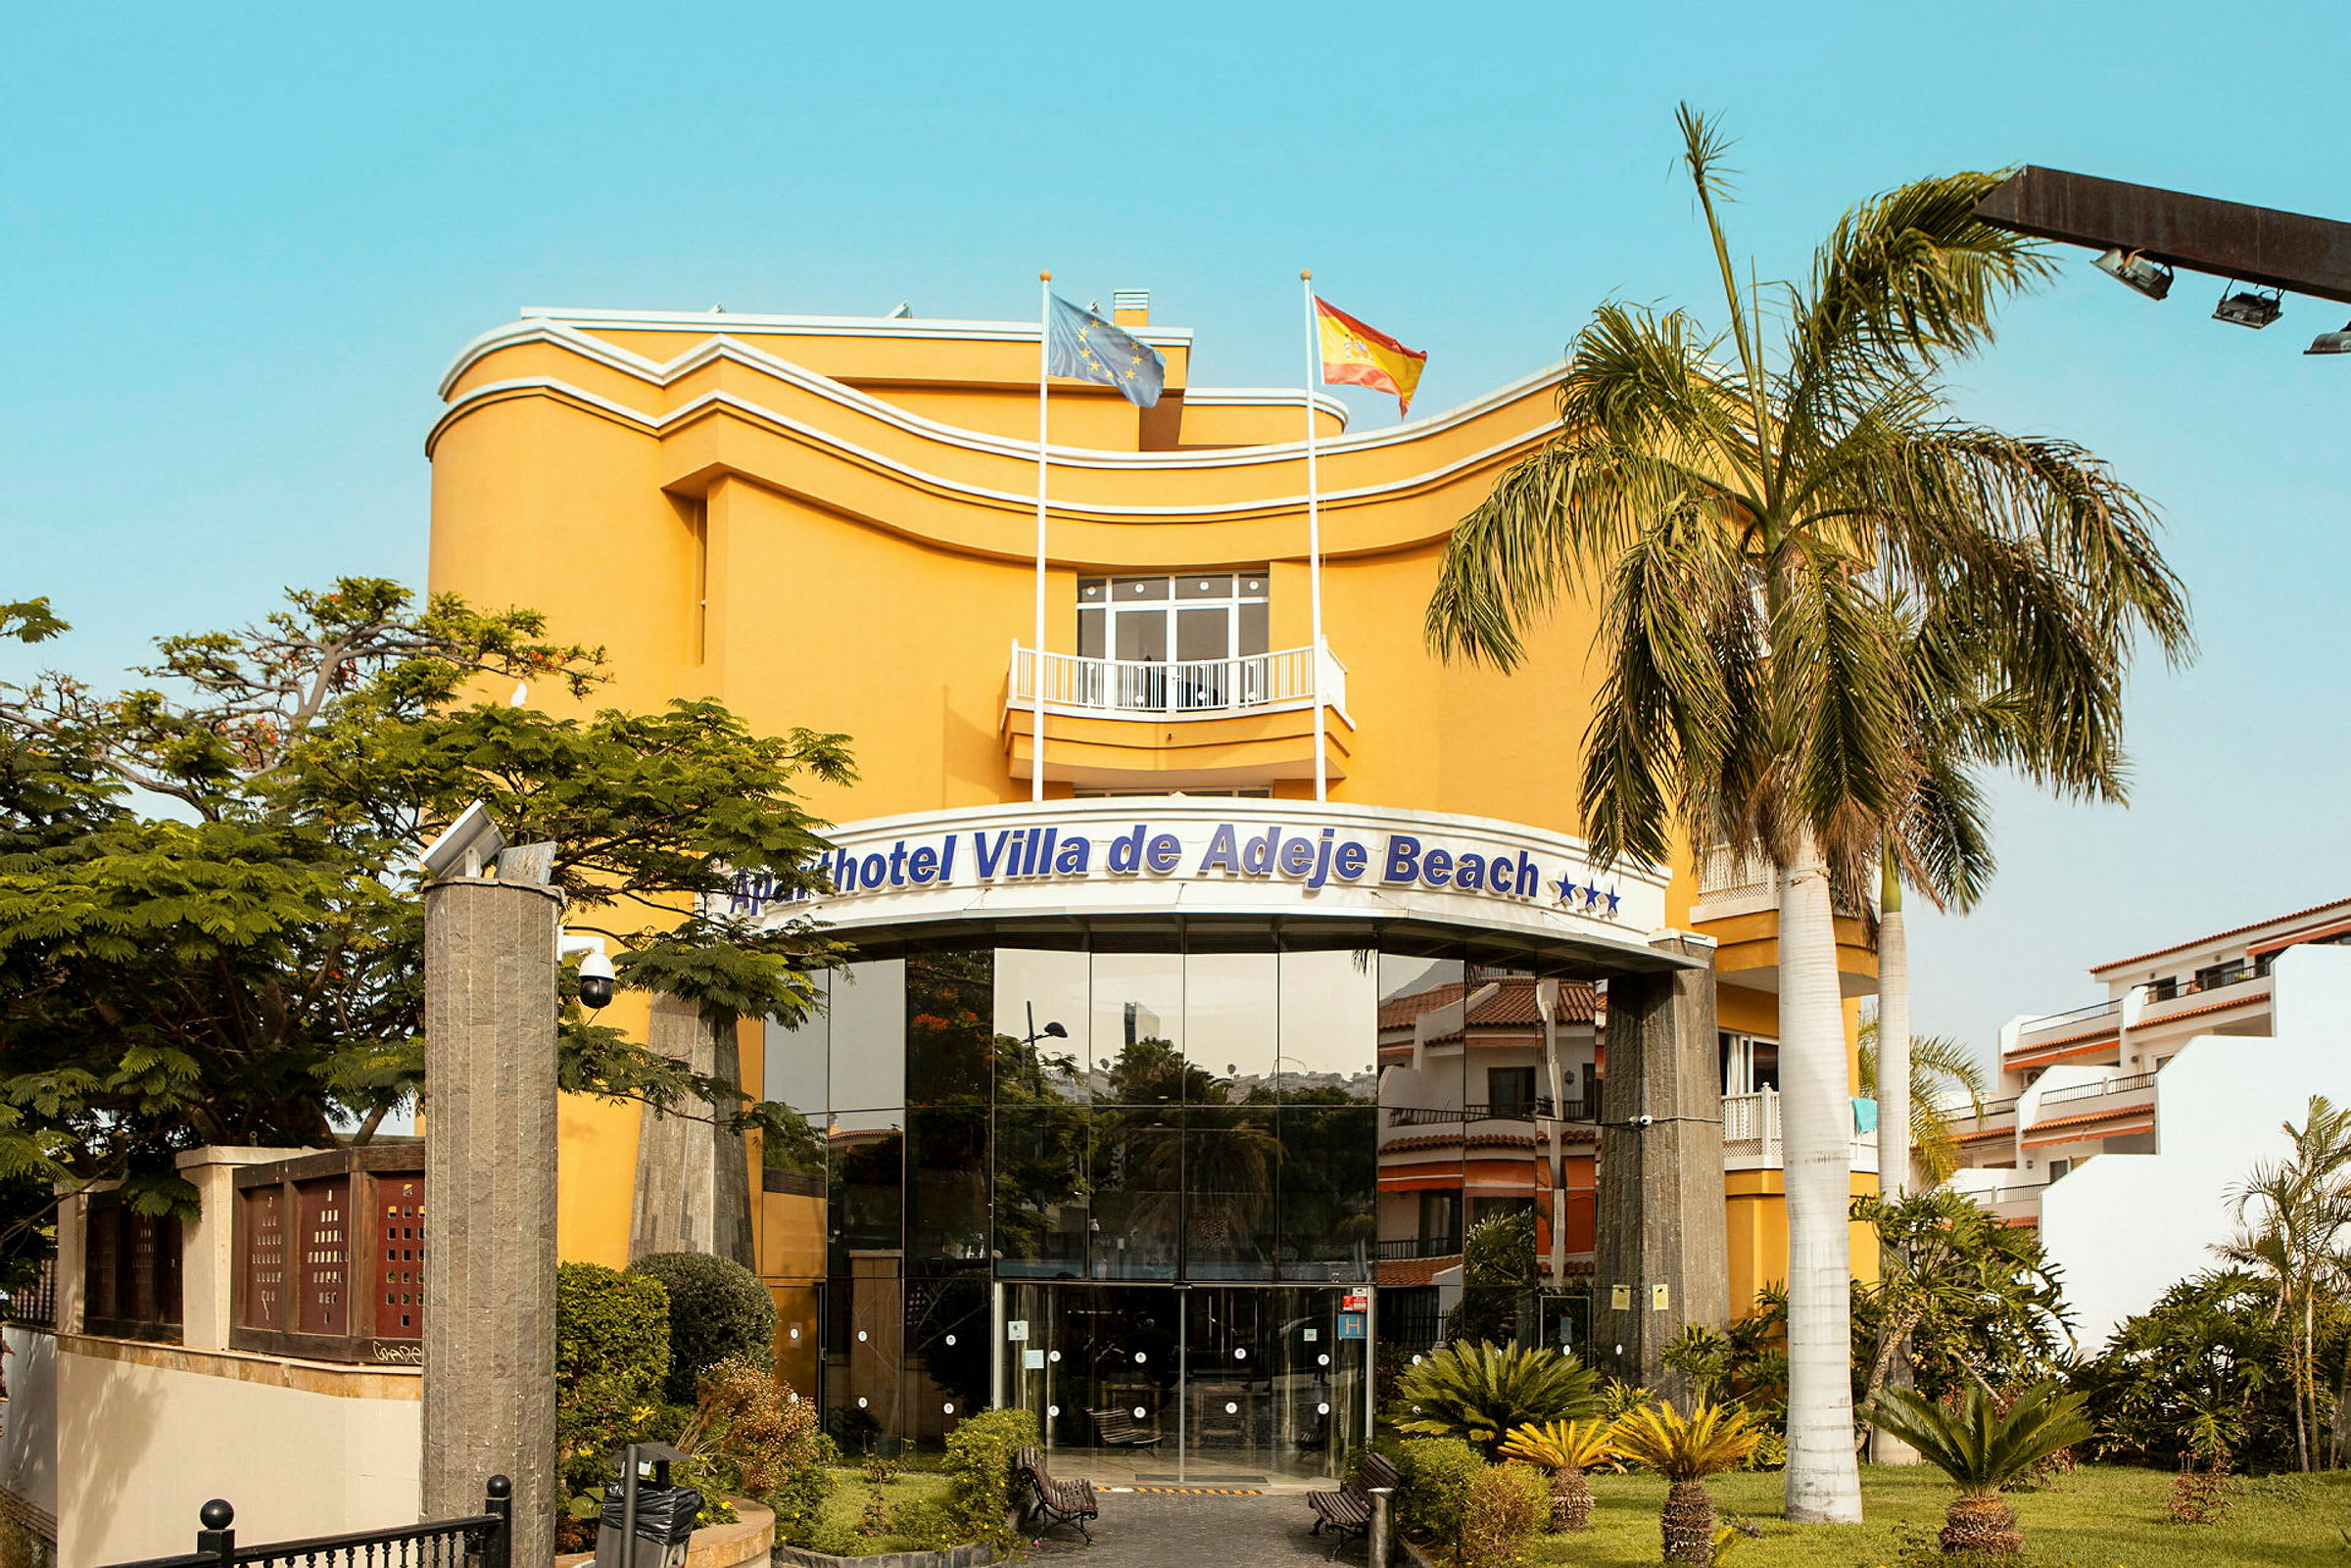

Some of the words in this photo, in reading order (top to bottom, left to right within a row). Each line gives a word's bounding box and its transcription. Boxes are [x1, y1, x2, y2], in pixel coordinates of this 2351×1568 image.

[974, 827, 1091, 881] Villa
[1108, 824, 1181, 875] de
[1201, 823, 1368, 890] Adeje
[1382, 833, 1539, 899] Beach
[1345, 1316, 1361, 1335] H
